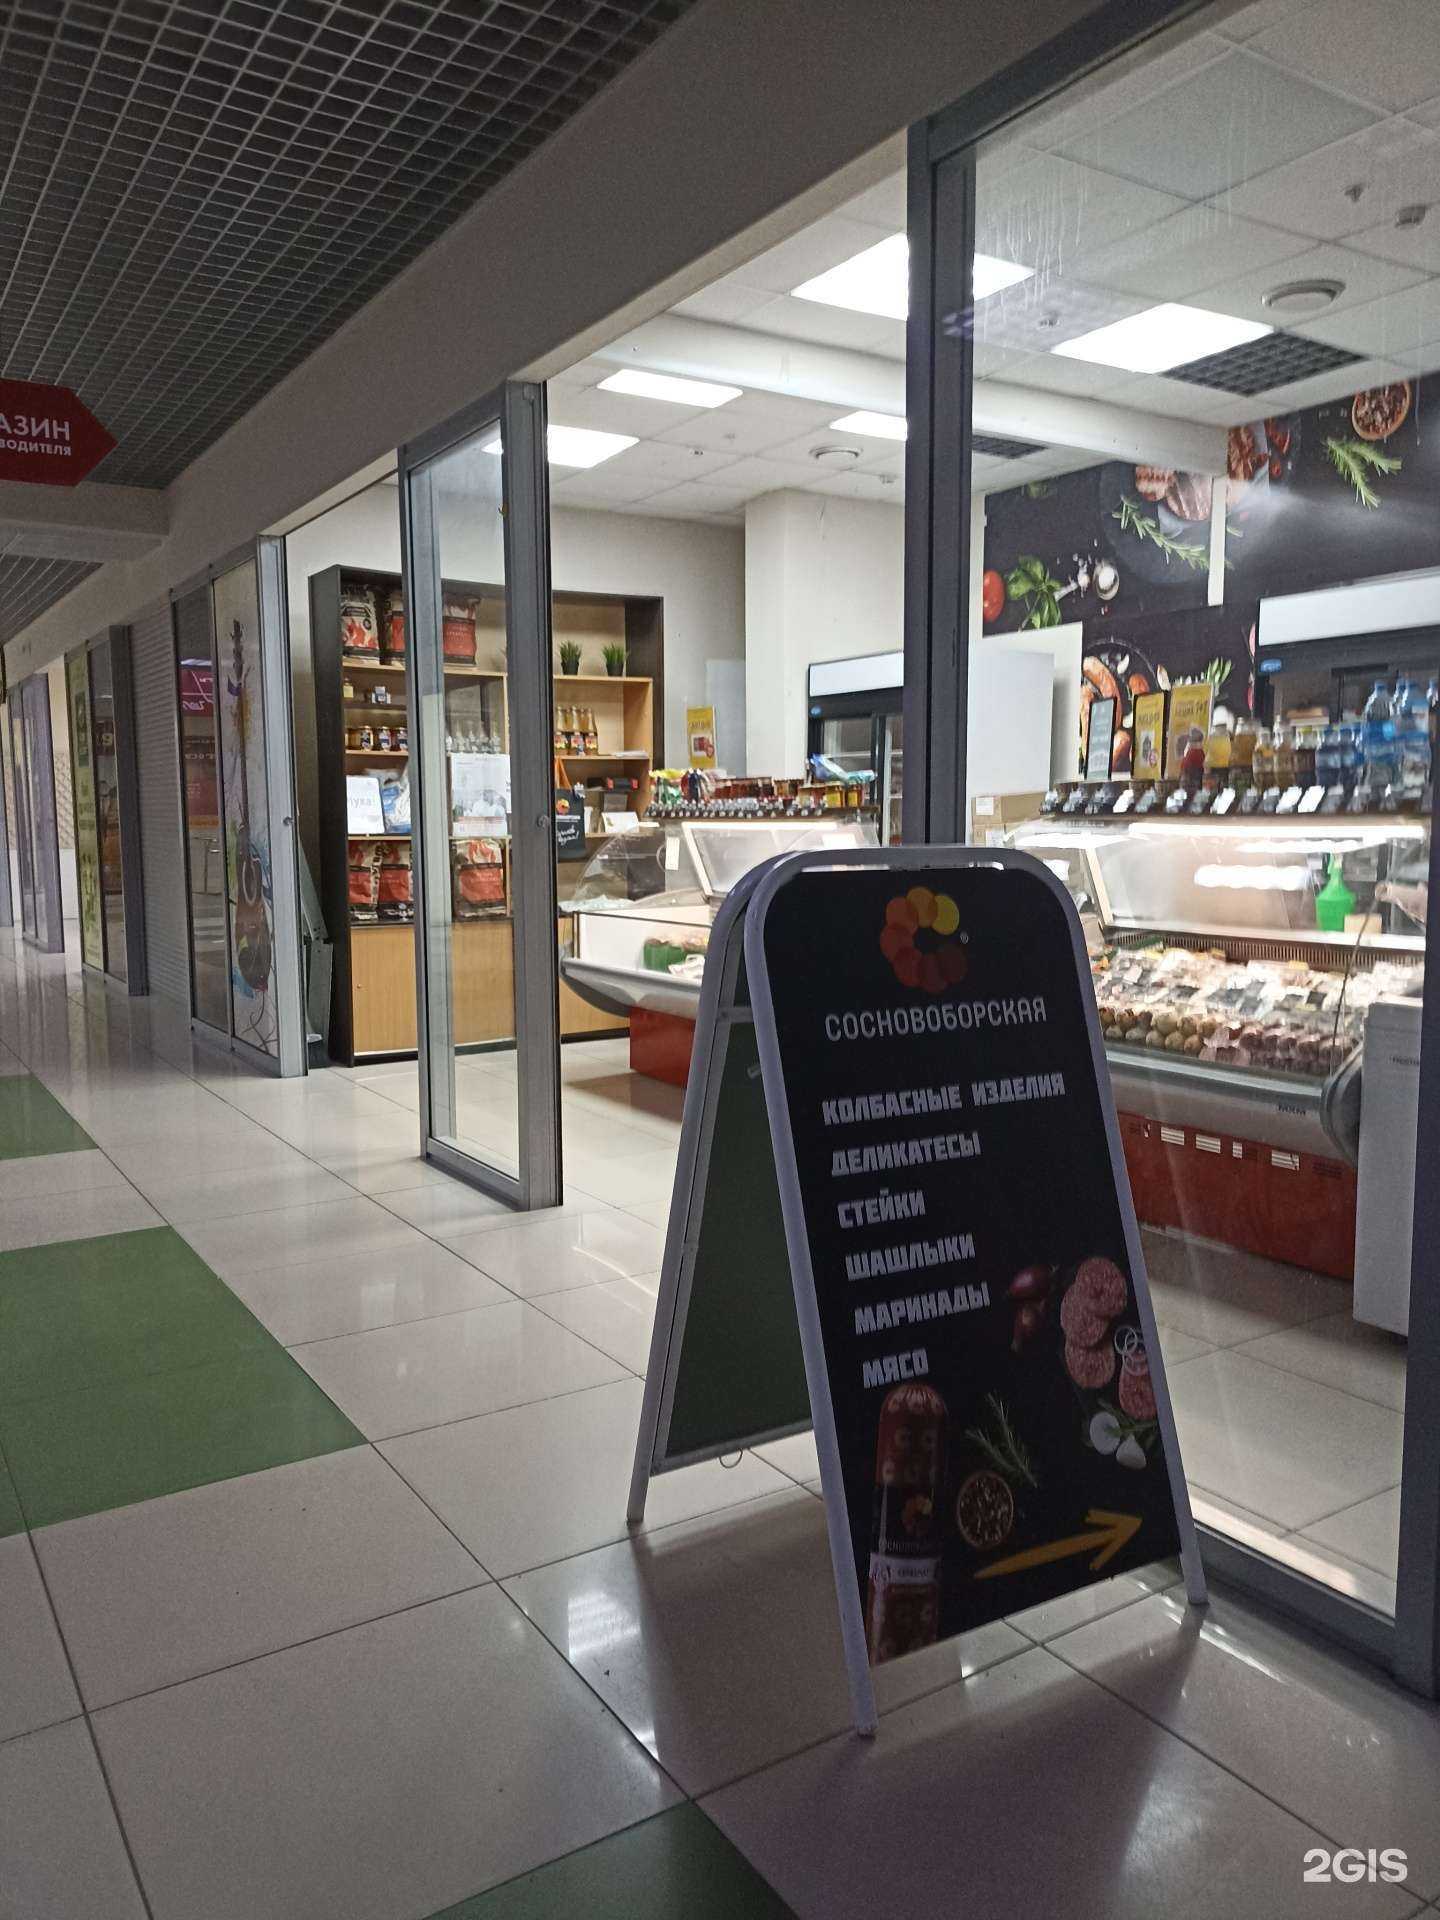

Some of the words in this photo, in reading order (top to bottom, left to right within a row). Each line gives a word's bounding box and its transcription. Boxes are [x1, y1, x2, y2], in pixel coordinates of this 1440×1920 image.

[825, 997, 1047, 1041] СОСНОВОБОРСКАЯ
[822, 1083, 962, 1125] КОЛБАСНЫЕ
[971, 1072, 1065, 1106] ИЗДЕЛИЯ
[831, 1131, 981, 1177] ДЕЛИКАТЕСЫ
[837, 1188, 926, 1229] СТЕЙКИ
[845, 1233, 976, 1281] ШАШЛЫКИ
[854, 1282, 990, 1335] МАРИНАДЫ
[863, 1348, 929, 1389] МЯСО
